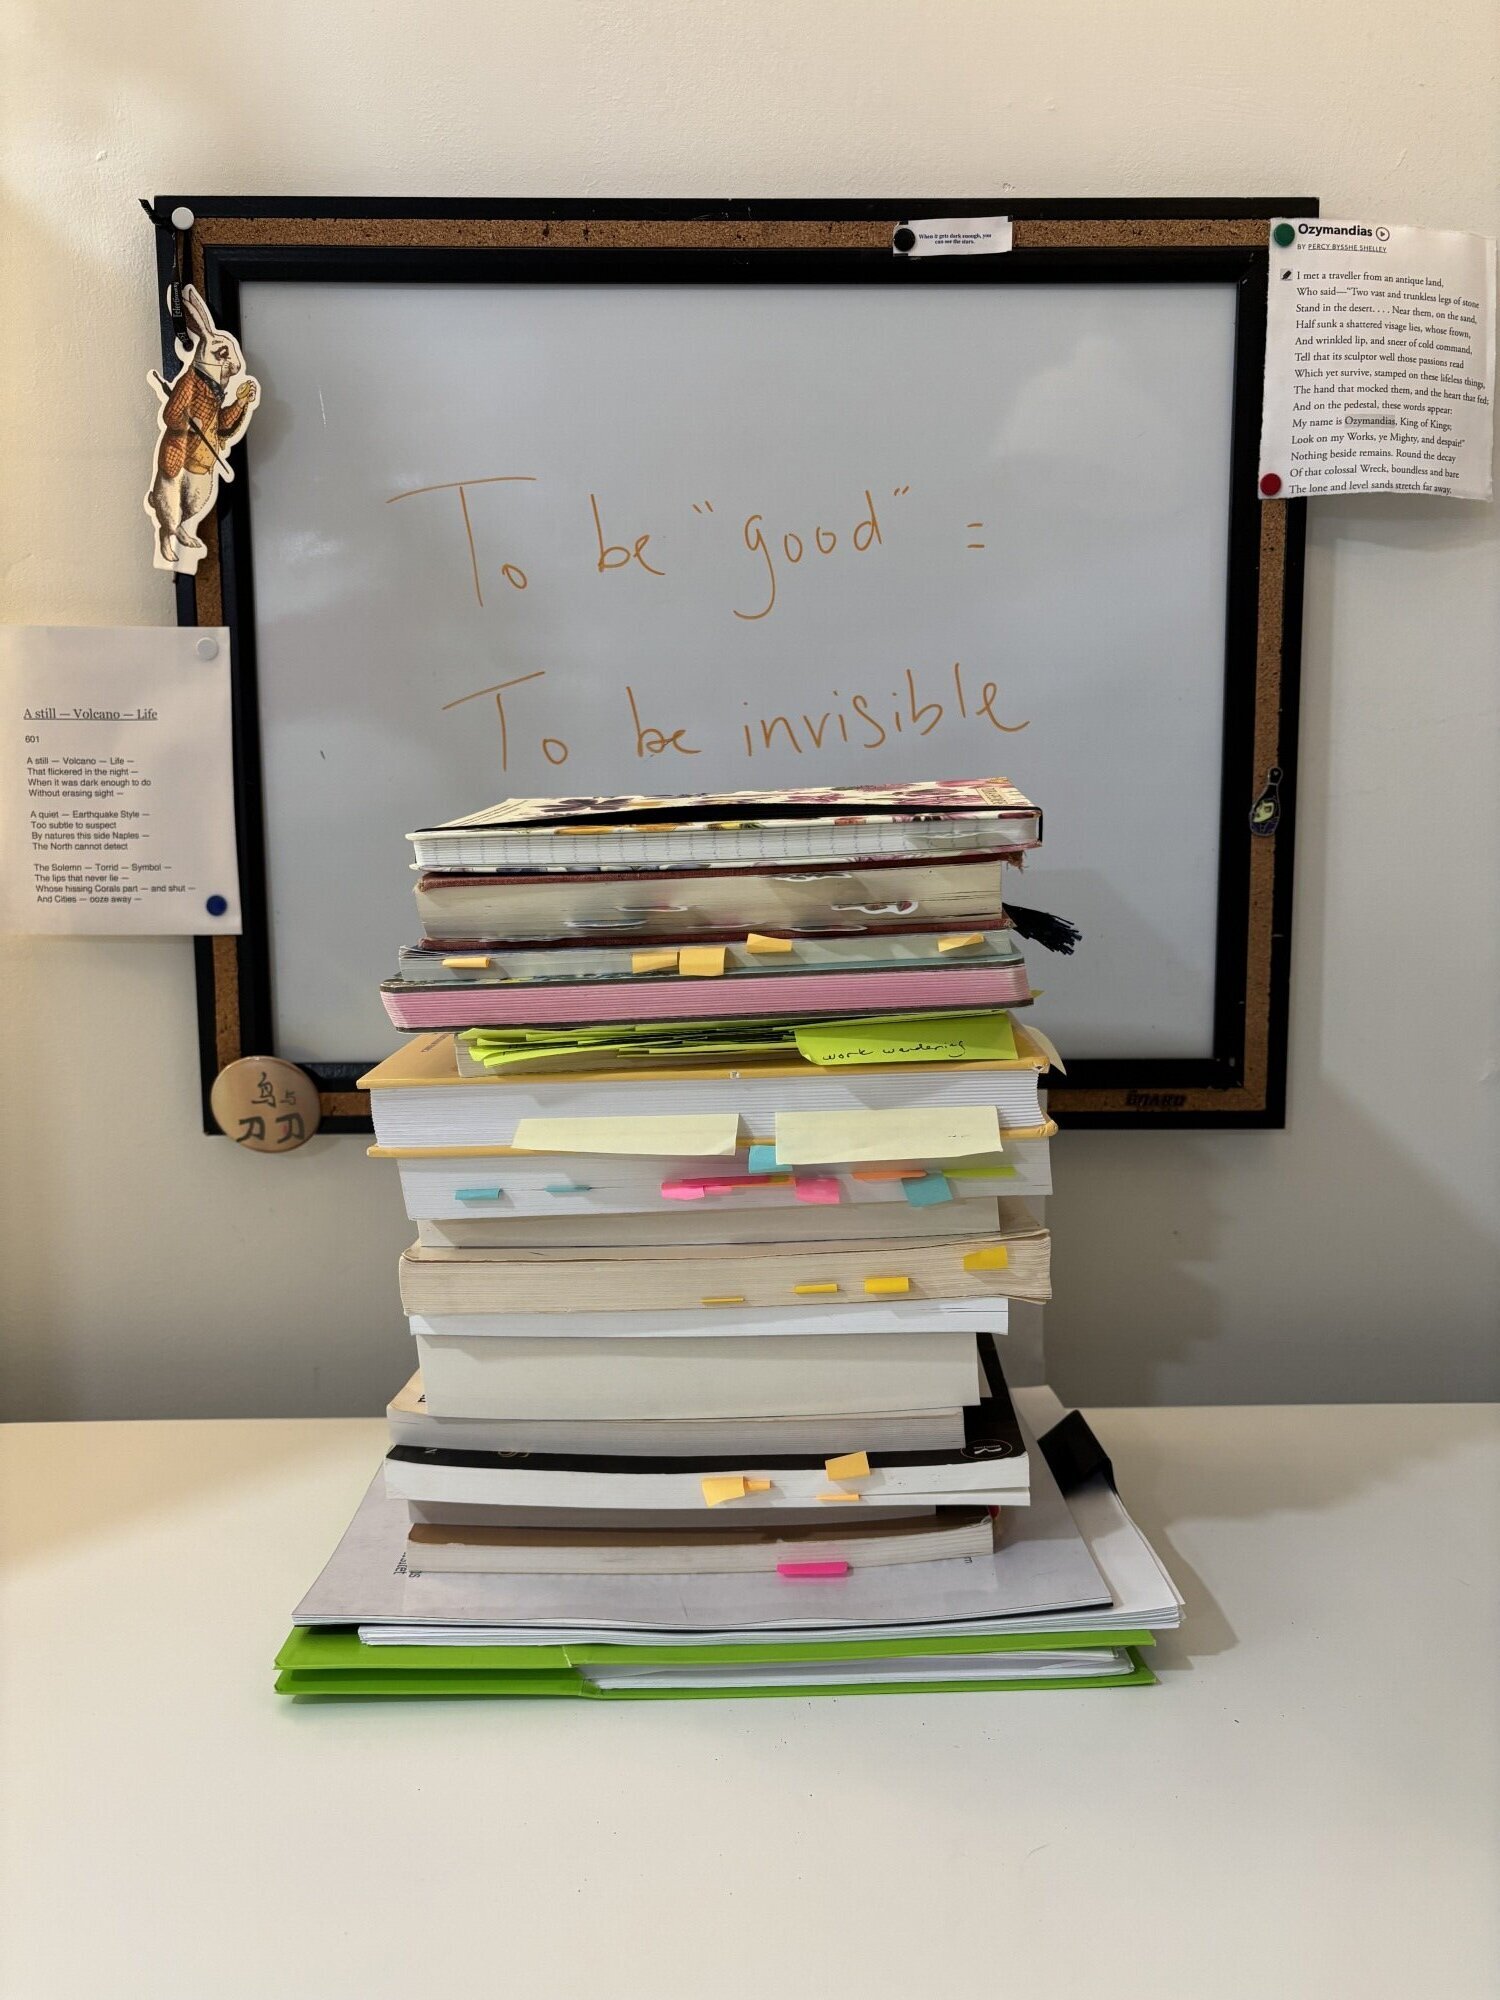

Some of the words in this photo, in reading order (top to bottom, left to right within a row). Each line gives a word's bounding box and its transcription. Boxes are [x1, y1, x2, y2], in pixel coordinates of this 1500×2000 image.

[1298, 224, 1373, 237] Ozymandias
[1360, 245, 1387, 253] SHELLEY
[1297, 271, 1300, 280] I
[1329, 271, 1361, 280] traveller
[1364, 272, 1382, 281] from
[1396, 274, 1424, 287] antique
[1296, 303, 1320, 313] Stand
[1323, 304, 1331, 312] in
[1334, 302, 1347, 312] the
[1392, 306, 1411, 315] Near
[1448, 311, 1459, 321] the
[1296, 319, 1317, 329] Half
[1317, 319, 1338, 329] sunk
[1346, 319, 1382, 329] shattered
[1384, 322, 1407, 333] visage
[1425, 325, 1447, 335] whose
[1295, 336, 1314, 345] And
[1316, 335, 1353, 344] wrinkled
[1370, 336, 1385, 345] and
[1409, 339, 1418, 348] of
[1418, 340, 1434, 349] cold
[1294, 352, 1311, 362] Tell
[1314, 352, 1330, 361] that
[1333, 352, 1342, 361] its
[1344, 352, 1378, 363] sculptor
[1379, 352, 1395, 361] well
[1398, 354, 1417, 363] those
[1419, 358, 1448, 367] passions
[1450, 360, 1464, 369] read
[1294, 368, 1323, 378] Which
[1326, 370, 1339, 380] yet
[1374, 370, 1407, 380] stamped
[1421, 371, 1439, 381] these
[1440, 373, 1463, 384] lifeless
[1293, 401, 1311, 411] And
[1328, 400, 1342, 409] the
[1382, 400, 1401, 410] these
[1403, 403, 1426, 412] words
[1292, 419, 1308, 429] My
[1336, 417, 1343, 425] is
[1400, 417, 1419, 430] King
[1420, 418, 1429, 427] of
[1292, 434, 1314, 445] Look
[1330, 436, 1345, 444] my
[1378, 435, 1388, 443] ye
[1421, 435, 1435, 444] and
[1291, 451, 1328, 461] Nothing
[1330, 448, 1357, 458] beside
[1396, 449, 1422, 459] Round
[1424, 451, 1435, 460] the
[1437, 452, 1456, 464] decay
[1290, 468, 1304, 478] Of
[1305, 467, 1322, 477] that
[1324, 464, 1357, 475] colossal
[1392, 464, 1428, 475] boundless
[1430, 468, 1443, 477] and
[1445, 468, 1459, 478] bare
[1289, 484, 1307, 494] The
[1309, 484, 1328, 492] lone
[1330, 481, 1347, 492] and
[1349, 480, 1369, 492] level
[1371, 480, 1394, 490] sands
[1395, 482, 1420, 491] stretch
[1423, 482, 1433, 491] far
[386, 476, 537, 608] To
[590, 492, 665, 575] be
[23, 708, 33, 719] A
[35, 708, 56, 719] still
[73, 708, 121, 719] Volcano
[137, 708, 158, 719] Life
[441, 671, 569, 772] To
[626, 686, 702, 759] be
[743, 662, 1030, 758] invisible
[25, 735, 40, 743] 601
[27, 756, 33, 765] A
[35, 757, 49, 765] still
[62, 757, 97, 765] Volcano
[110, 757, 125, 765] Life
[27, 768, 46, 776] That
[48, 768, 83, 776] flickered
[85, 768, 93, 776] in
[94, 768, 108, 776] the
[110, 768, 129, 777] night
[28, 778, 52, 787] When
[80, 779, 99, 787] dark
[100, 779, 130, 788] enough
[132, 779, 140, 787] to
[28, 789, 60, 797] Without
[62, 790, 93, 799] erasing
[94, 790, 114, 799] sight
[30, 810, 37, 818] A
[38, 811, 59, 820] quiet
[72, 810, 119, 820] Earthquake
[120, 810, 140, 820] Style
[30, 821, 47, 829] Too
[49, 821, 74, 829] subtle
[86, 822, 117, 831] suspect
[34, 864, 50, 872] The
[52, 864, 82, 872] Solemn
[95, 863, 119, 871] Torrid
[132, 864, 161, 873] Symbol
[822, 1048, 873, 1060] work
